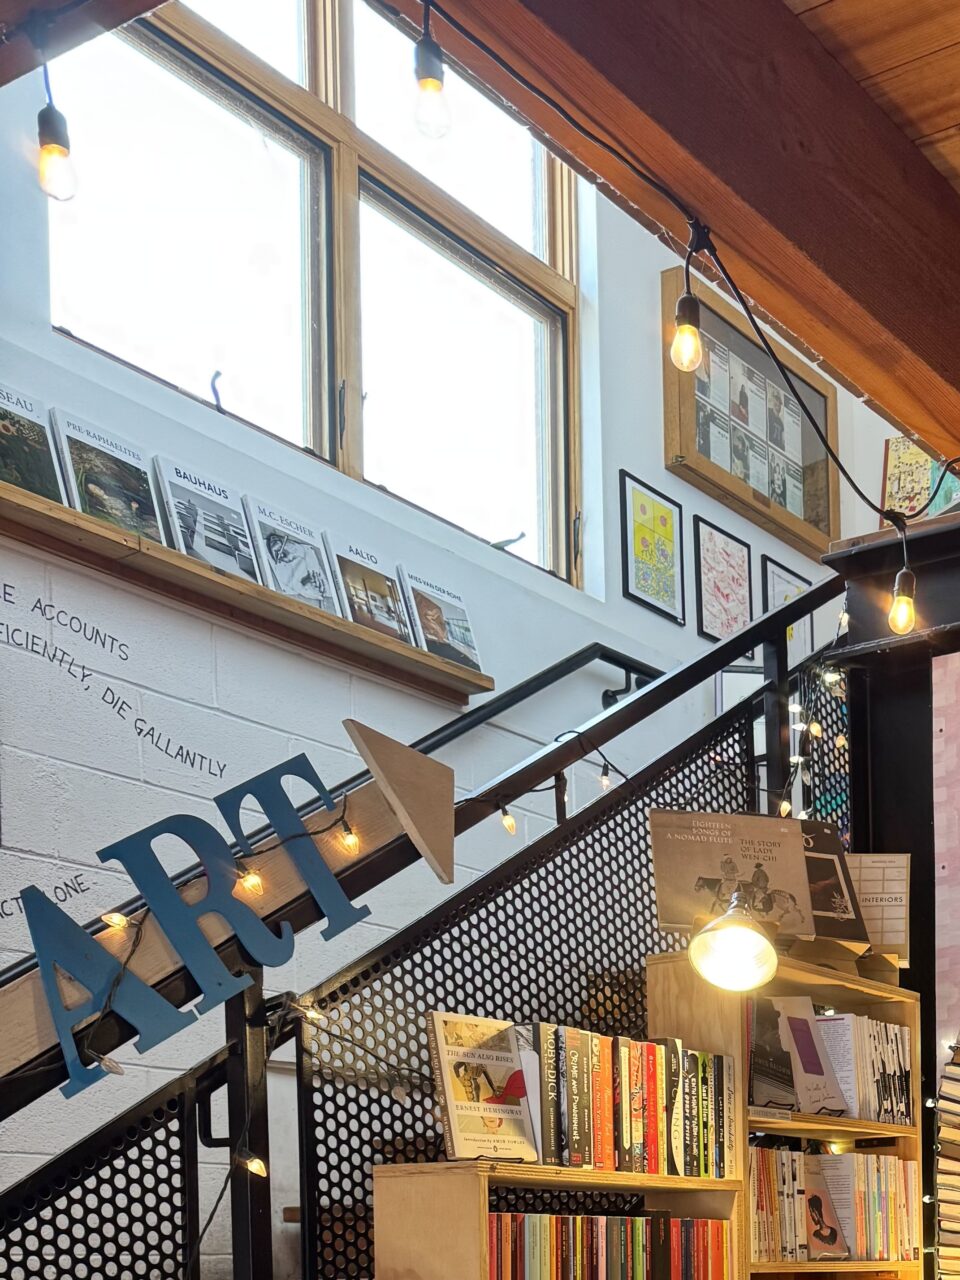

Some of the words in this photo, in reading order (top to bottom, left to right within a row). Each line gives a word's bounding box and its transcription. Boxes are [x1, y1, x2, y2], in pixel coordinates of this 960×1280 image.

[174, 467, 229, 500] BAUHAUS
[257, 505, 279, 522] M.C.
[348, 545, 379, 565] AALTO
[31, 598, 130, 662] ACCOUNTS
[101, 686, 132, 721] DIE
[134, 718, 227, 779] GALLANTLY
[861, 895, 903, 904] INTERIORS
[19, 752, 372, 1101] ART
[547, 1025, 557, 1101] MOBY-DICK
[455, 1104, 483, 1112] ERNEST
[486, 1107, 523, 1116] HEMINGWAY
